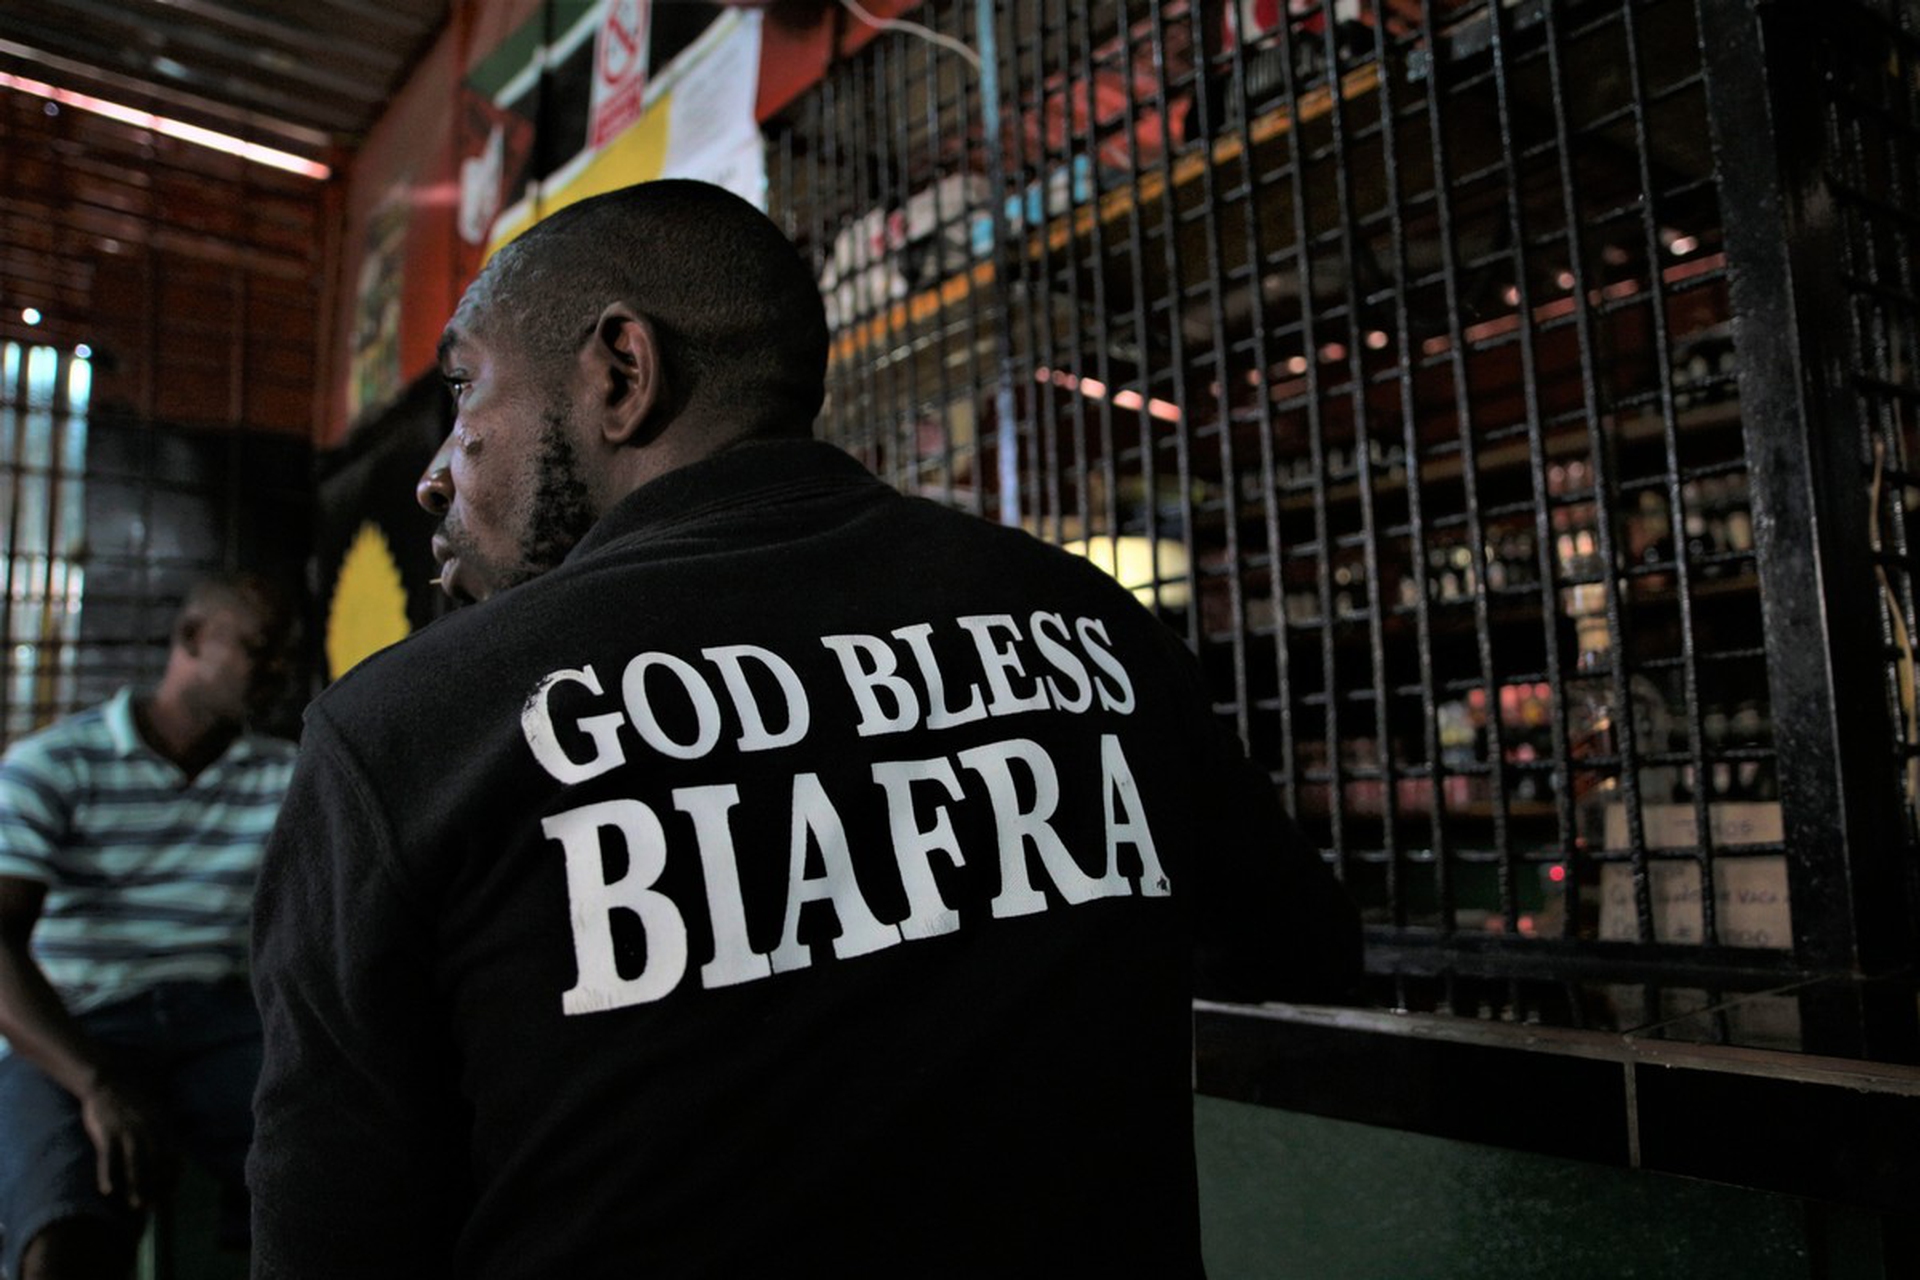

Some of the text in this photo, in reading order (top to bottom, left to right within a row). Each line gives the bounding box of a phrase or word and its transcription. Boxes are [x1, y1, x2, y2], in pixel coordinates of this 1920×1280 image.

[521, 610, 1137, 786] GOD BLESS
[541, 733, 1172, 1017] BIAFRA
